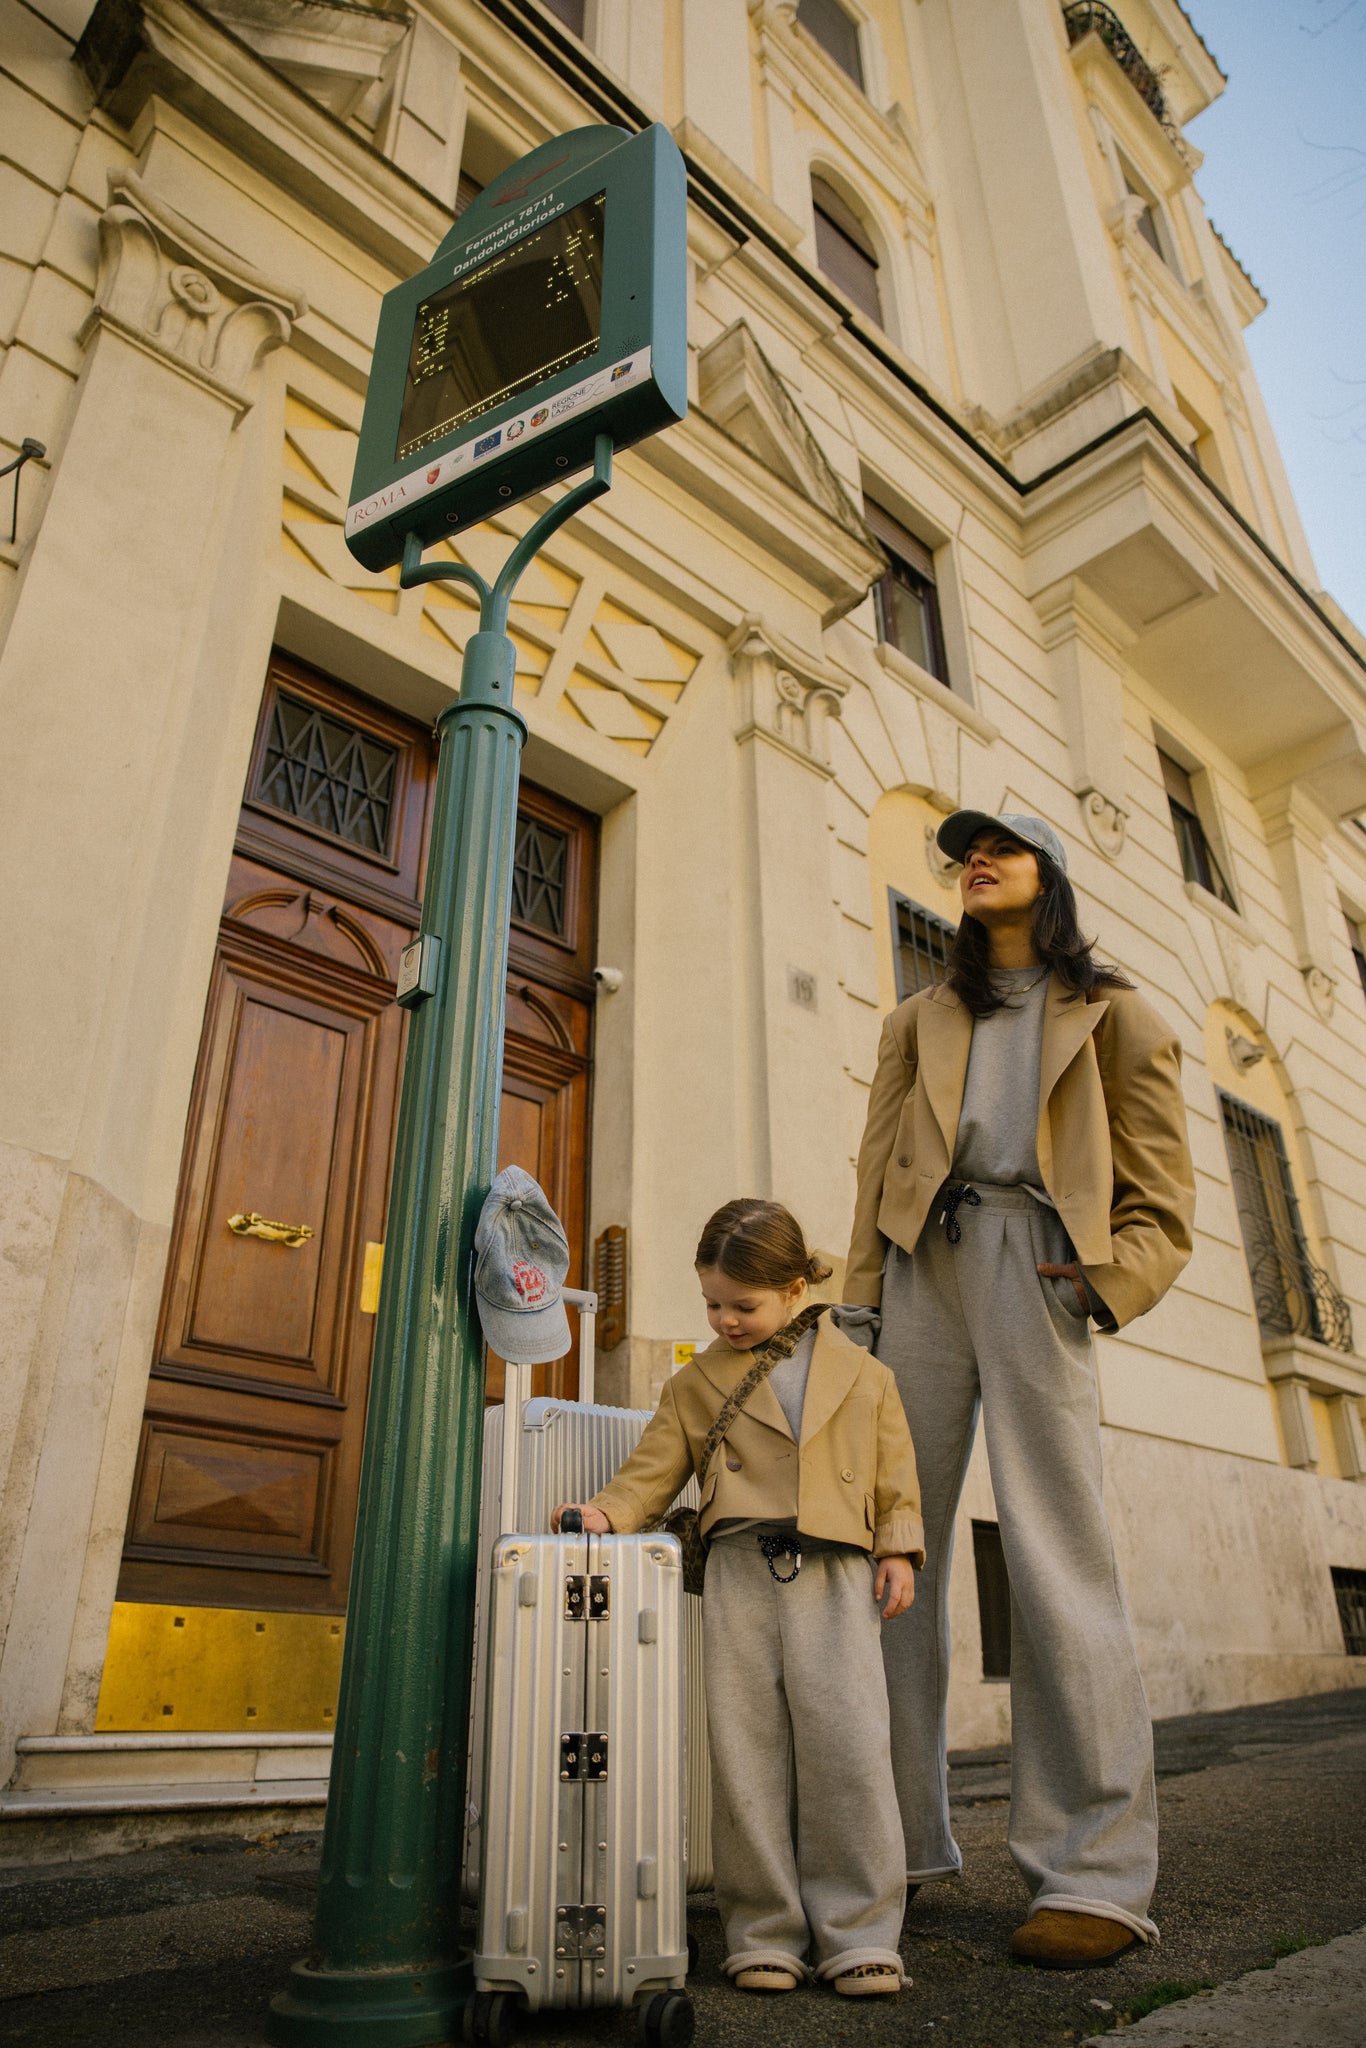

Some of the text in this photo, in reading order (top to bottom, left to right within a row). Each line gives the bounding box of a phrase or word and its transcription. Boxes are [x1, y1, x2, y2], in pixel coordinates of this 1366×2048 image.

[453, 202, 565, 276] Dandolo/Glorioso
[465, 193, 554, 254] Fermata 78711
[552, 386, 586, 410] REGIONE
[552, 401, 575, 418] LAZIO
[353, 486, 407, 524] ROMA
